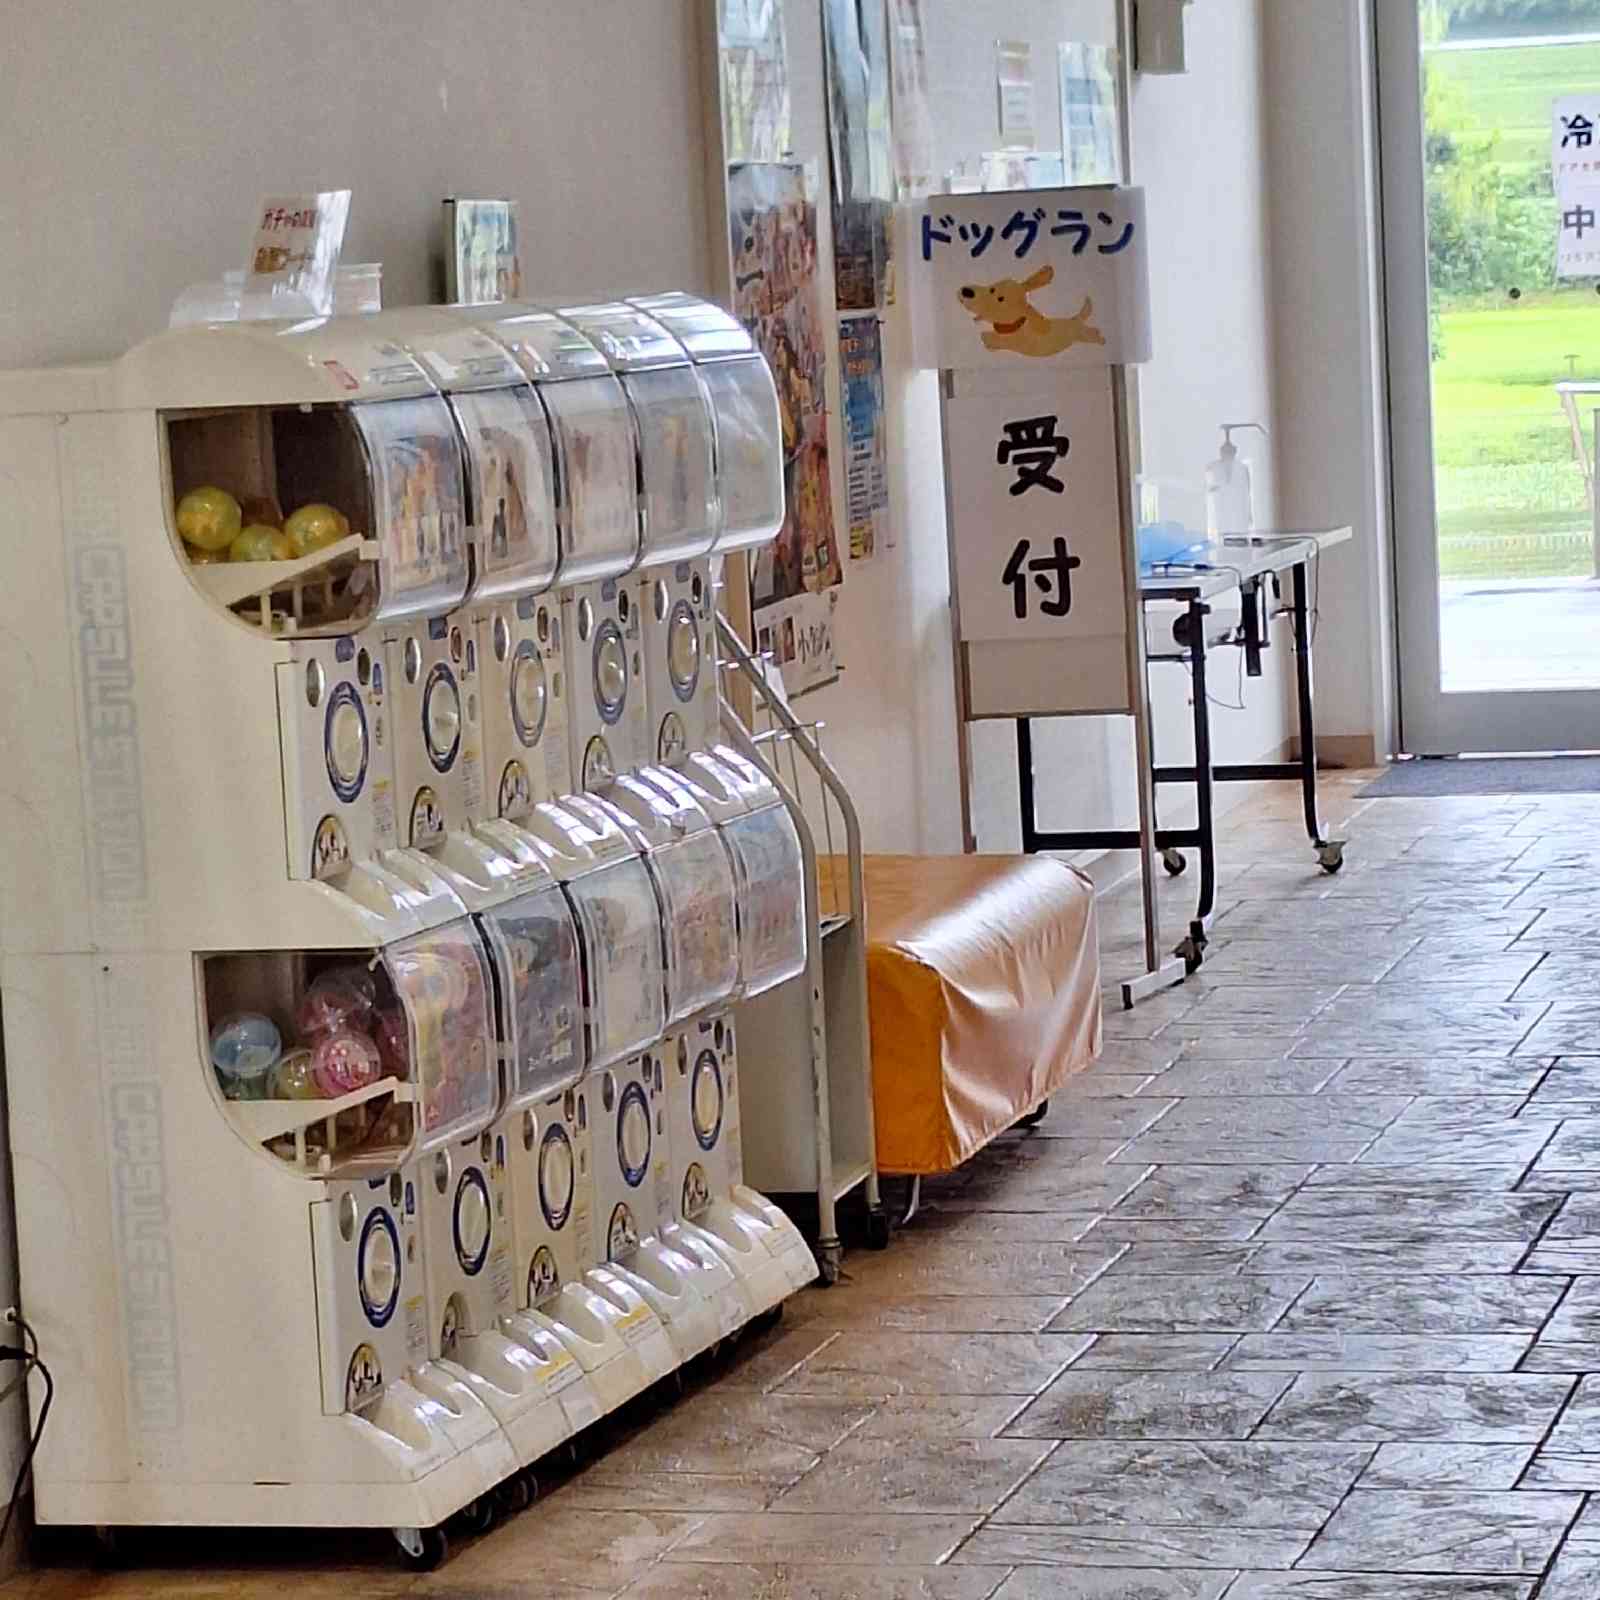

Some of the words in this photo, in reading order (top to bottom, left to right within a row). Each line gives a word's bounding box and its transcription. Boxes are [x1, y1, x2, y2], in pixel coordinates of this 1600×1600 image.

[1560, 114, 1600, 149] 冷
[921, 207, 1134, 261] ドッグラン
[1563, 204, 1595, 240] 中
[997, 415, 1081, 619] 受付
